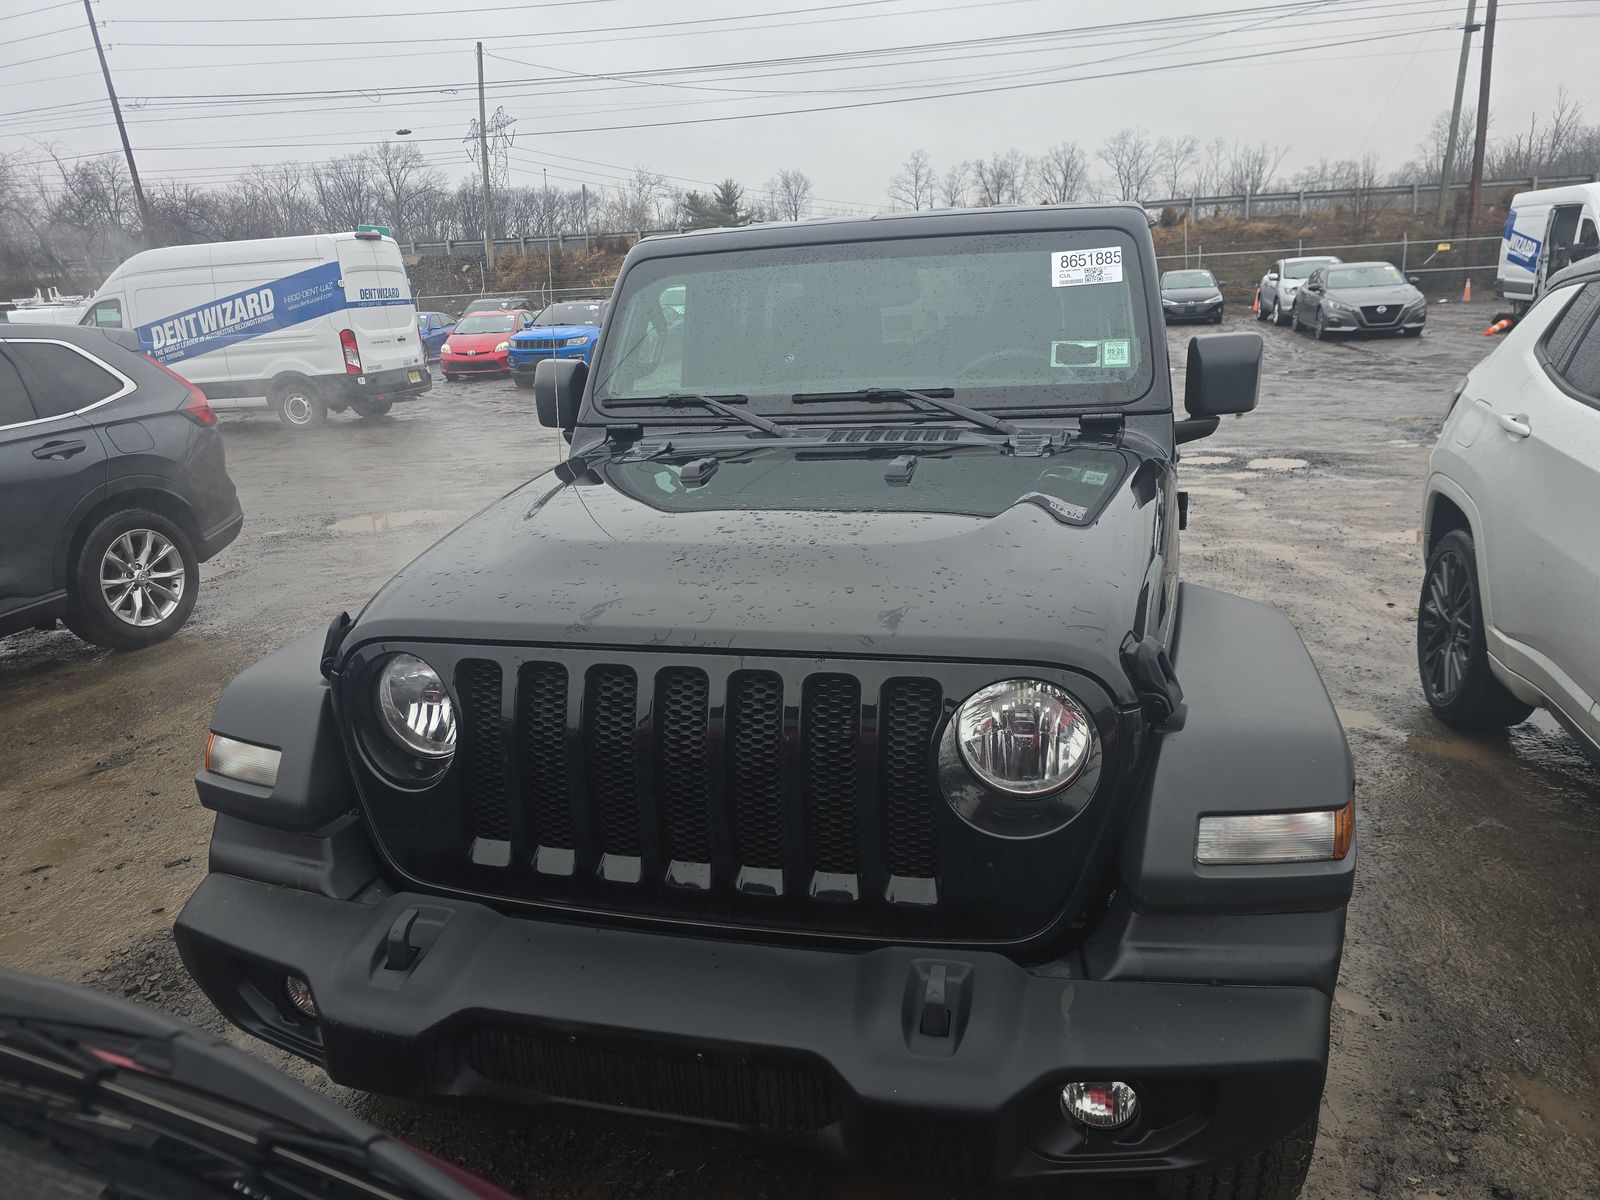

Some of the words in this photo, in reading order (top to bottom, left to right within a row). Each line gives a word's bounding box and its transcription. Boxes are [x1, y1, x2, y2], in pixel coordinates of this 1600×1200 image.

[1060, 250, 1121, 268] 8651885
[154, 348, 164, 356] THE
[164, 343, 181, 353] WORLD
[181, 338, 199, 348] LEADER
[205, 328, 235, 339] AUTOMOTIVE
[235, 313, 274, 331] RECONDITIONING
[166, 350, 184, 361] DIVISION
